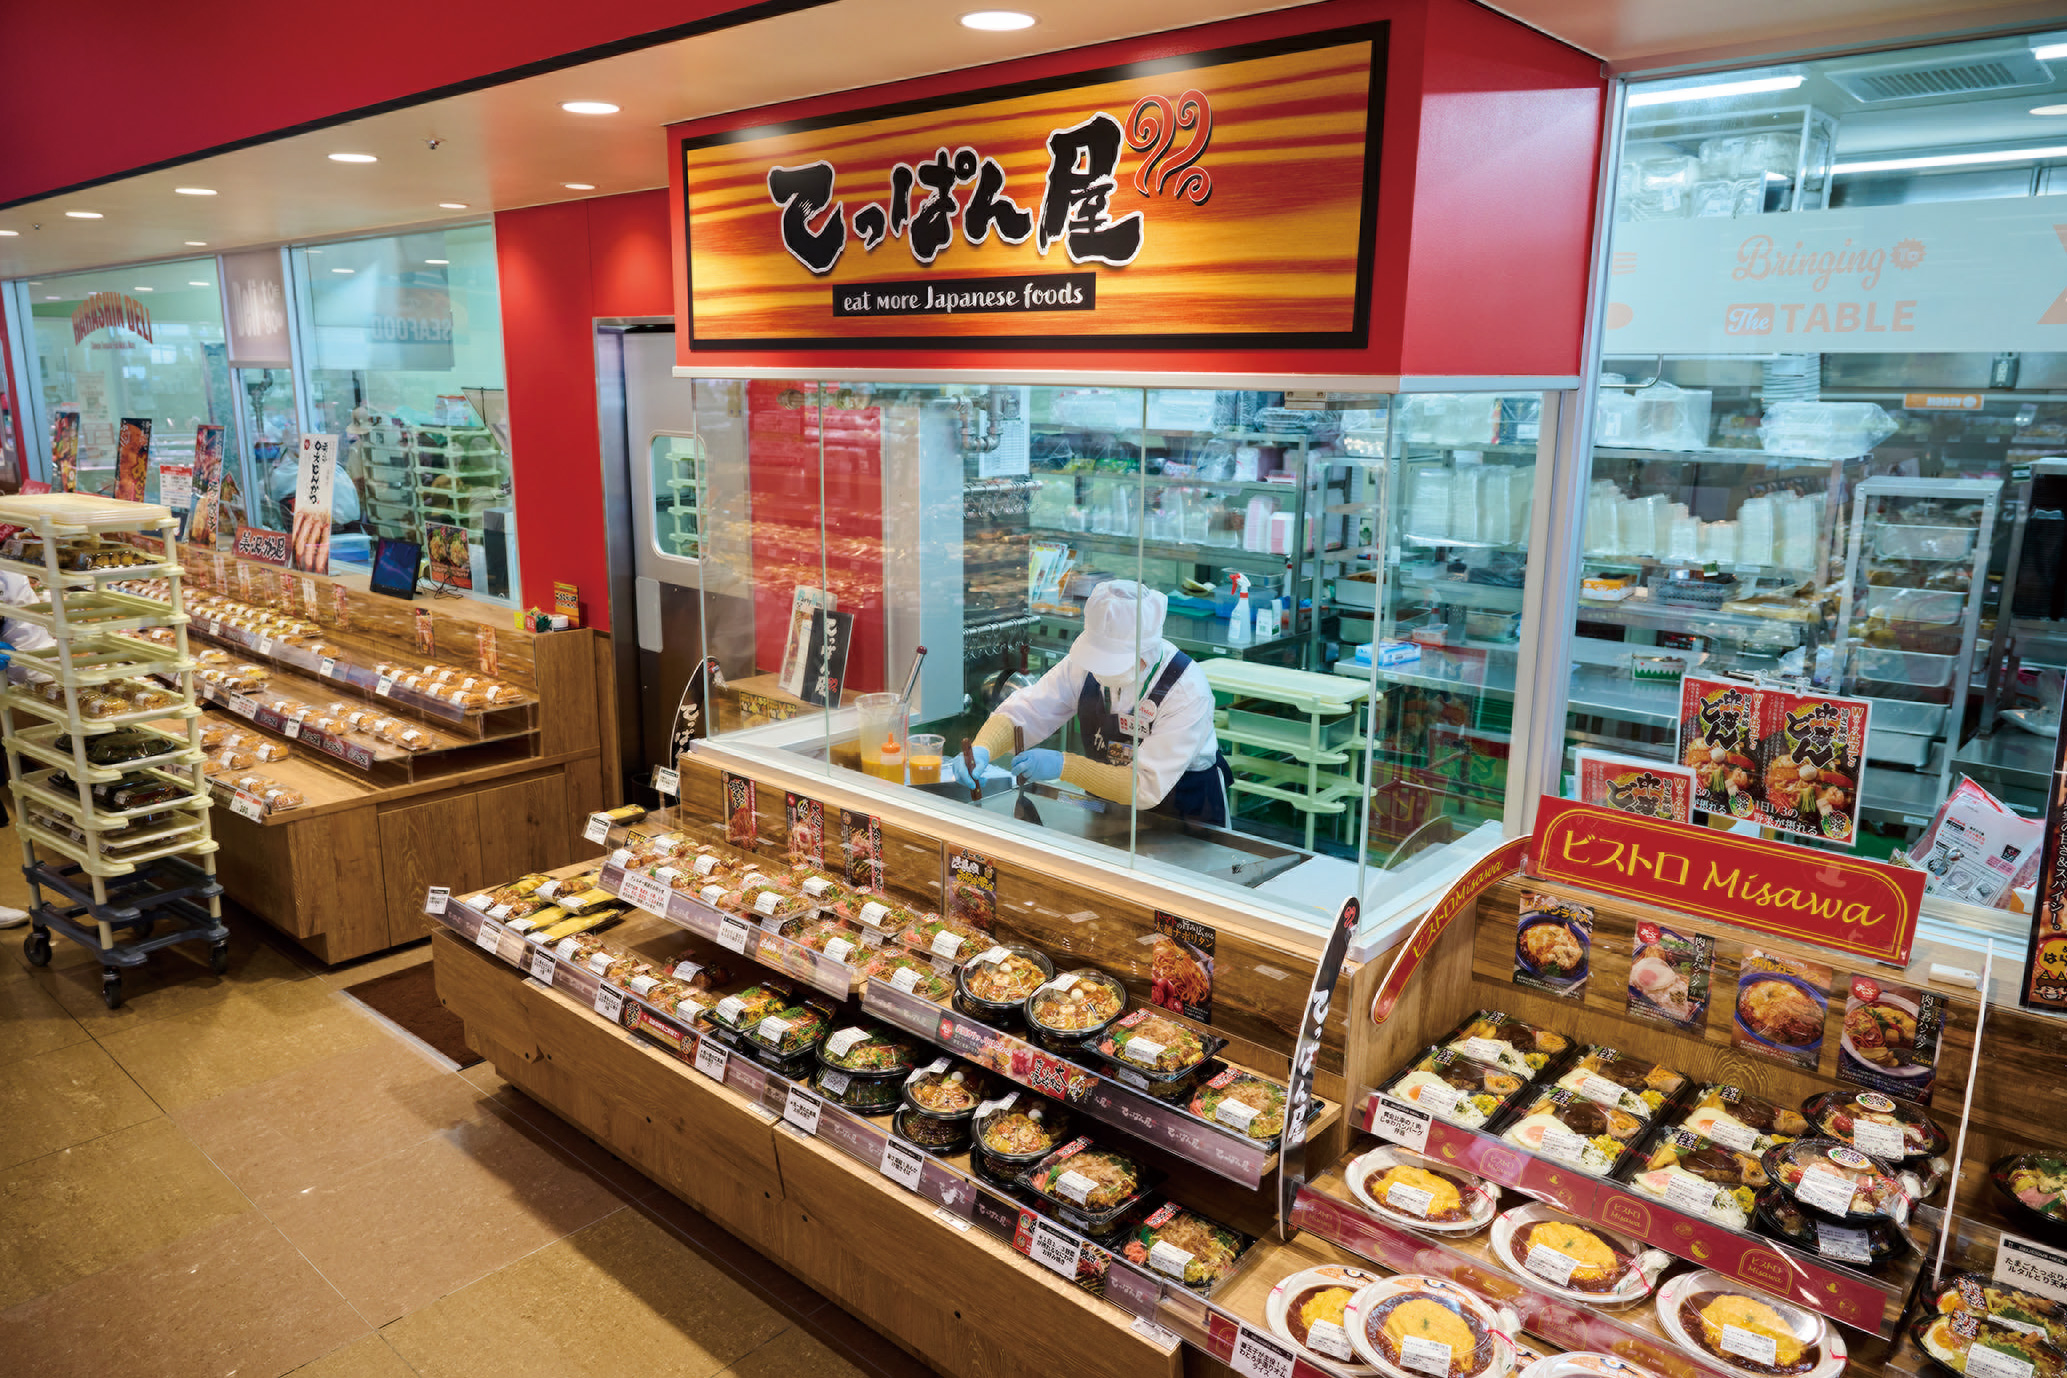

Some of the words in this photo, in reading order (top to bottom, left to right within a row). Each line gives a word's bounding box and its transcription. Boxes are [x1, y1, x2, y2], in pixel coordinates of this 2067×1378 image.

[1731, 234, 1886, 292] Bringing
[843, 291, 871, 312] eat
[924, 285, 1020, 314] Japanese
[1023, 282, 1084, 309] foods
[1728, 307, 1770, 333] The
[1780, 300, 1918, 333] TABLE
[673, 703, 700, 762] てっぱん
[1753, 812, 1818, 836] 野菜が摂れる
[1561, 829, 1690, 886] ビストロ
[1702, 860, 1887, 926] Misawa
[1412, 899, 1455, 958] ビストロ
[1455, 859, 1504, 907] Misawa
[1610, 1209, 1642, 1228] Misawa
[1612, 1201, 1642, 1219] ビストロ
[2018, 1245, 2048, 1259] DELICIOUS
[1747, 1265, 1783, 1285] Misawa
[1253, 1361, 1270, 1377] ライス
